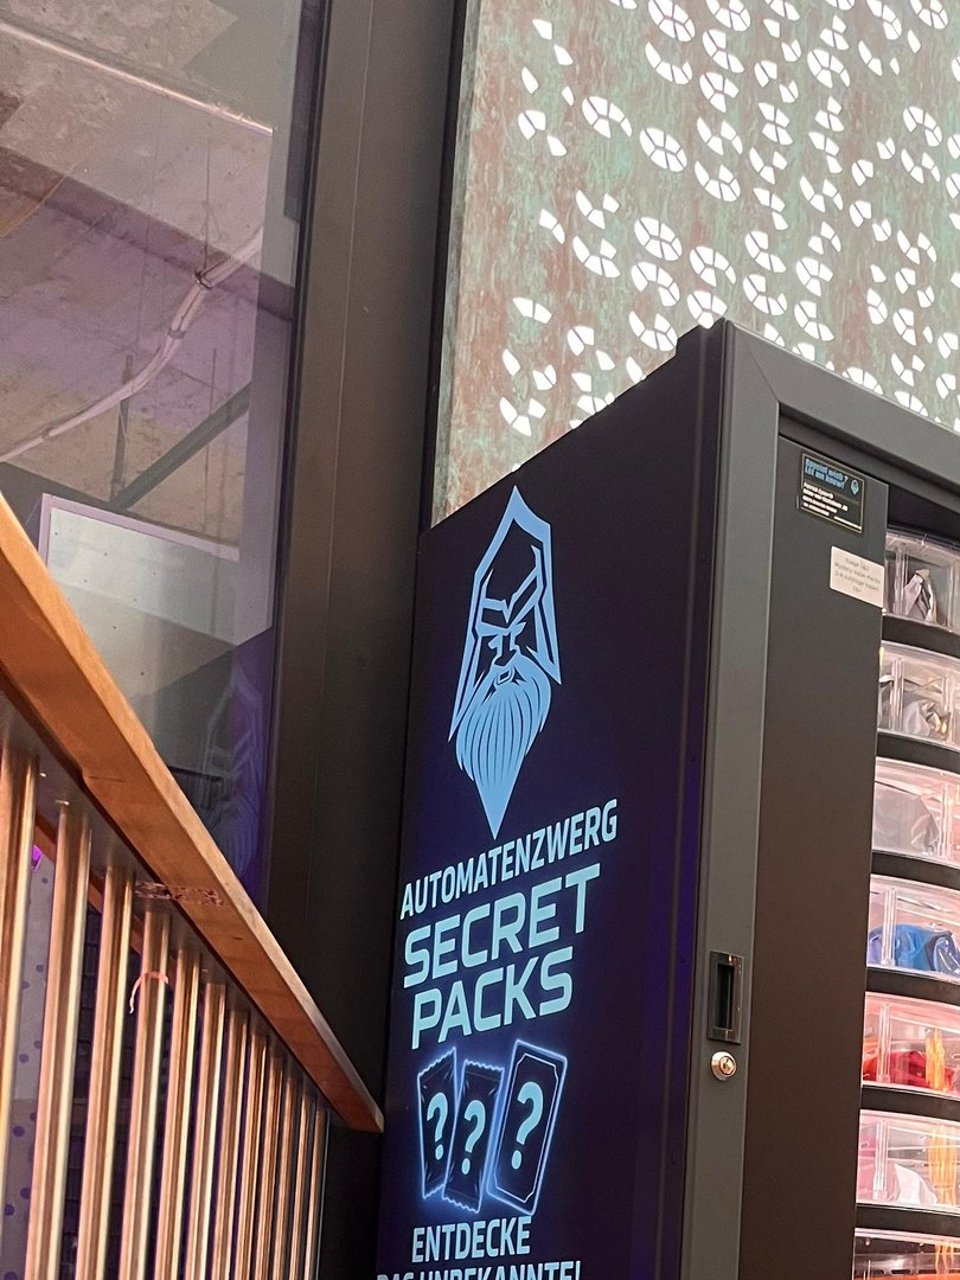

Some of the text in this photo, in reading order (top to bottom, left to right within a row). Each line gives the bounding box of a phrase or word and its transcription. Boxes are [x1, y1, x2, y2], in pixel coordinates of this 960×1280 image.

[400, 798, 617, 920] AUTOMATENZWERG
[404, 863, 600, 988] SECRET
[411, 946, 573, 1050] PACKS
[411, 1216, 532, 1262] ENTDECKE
